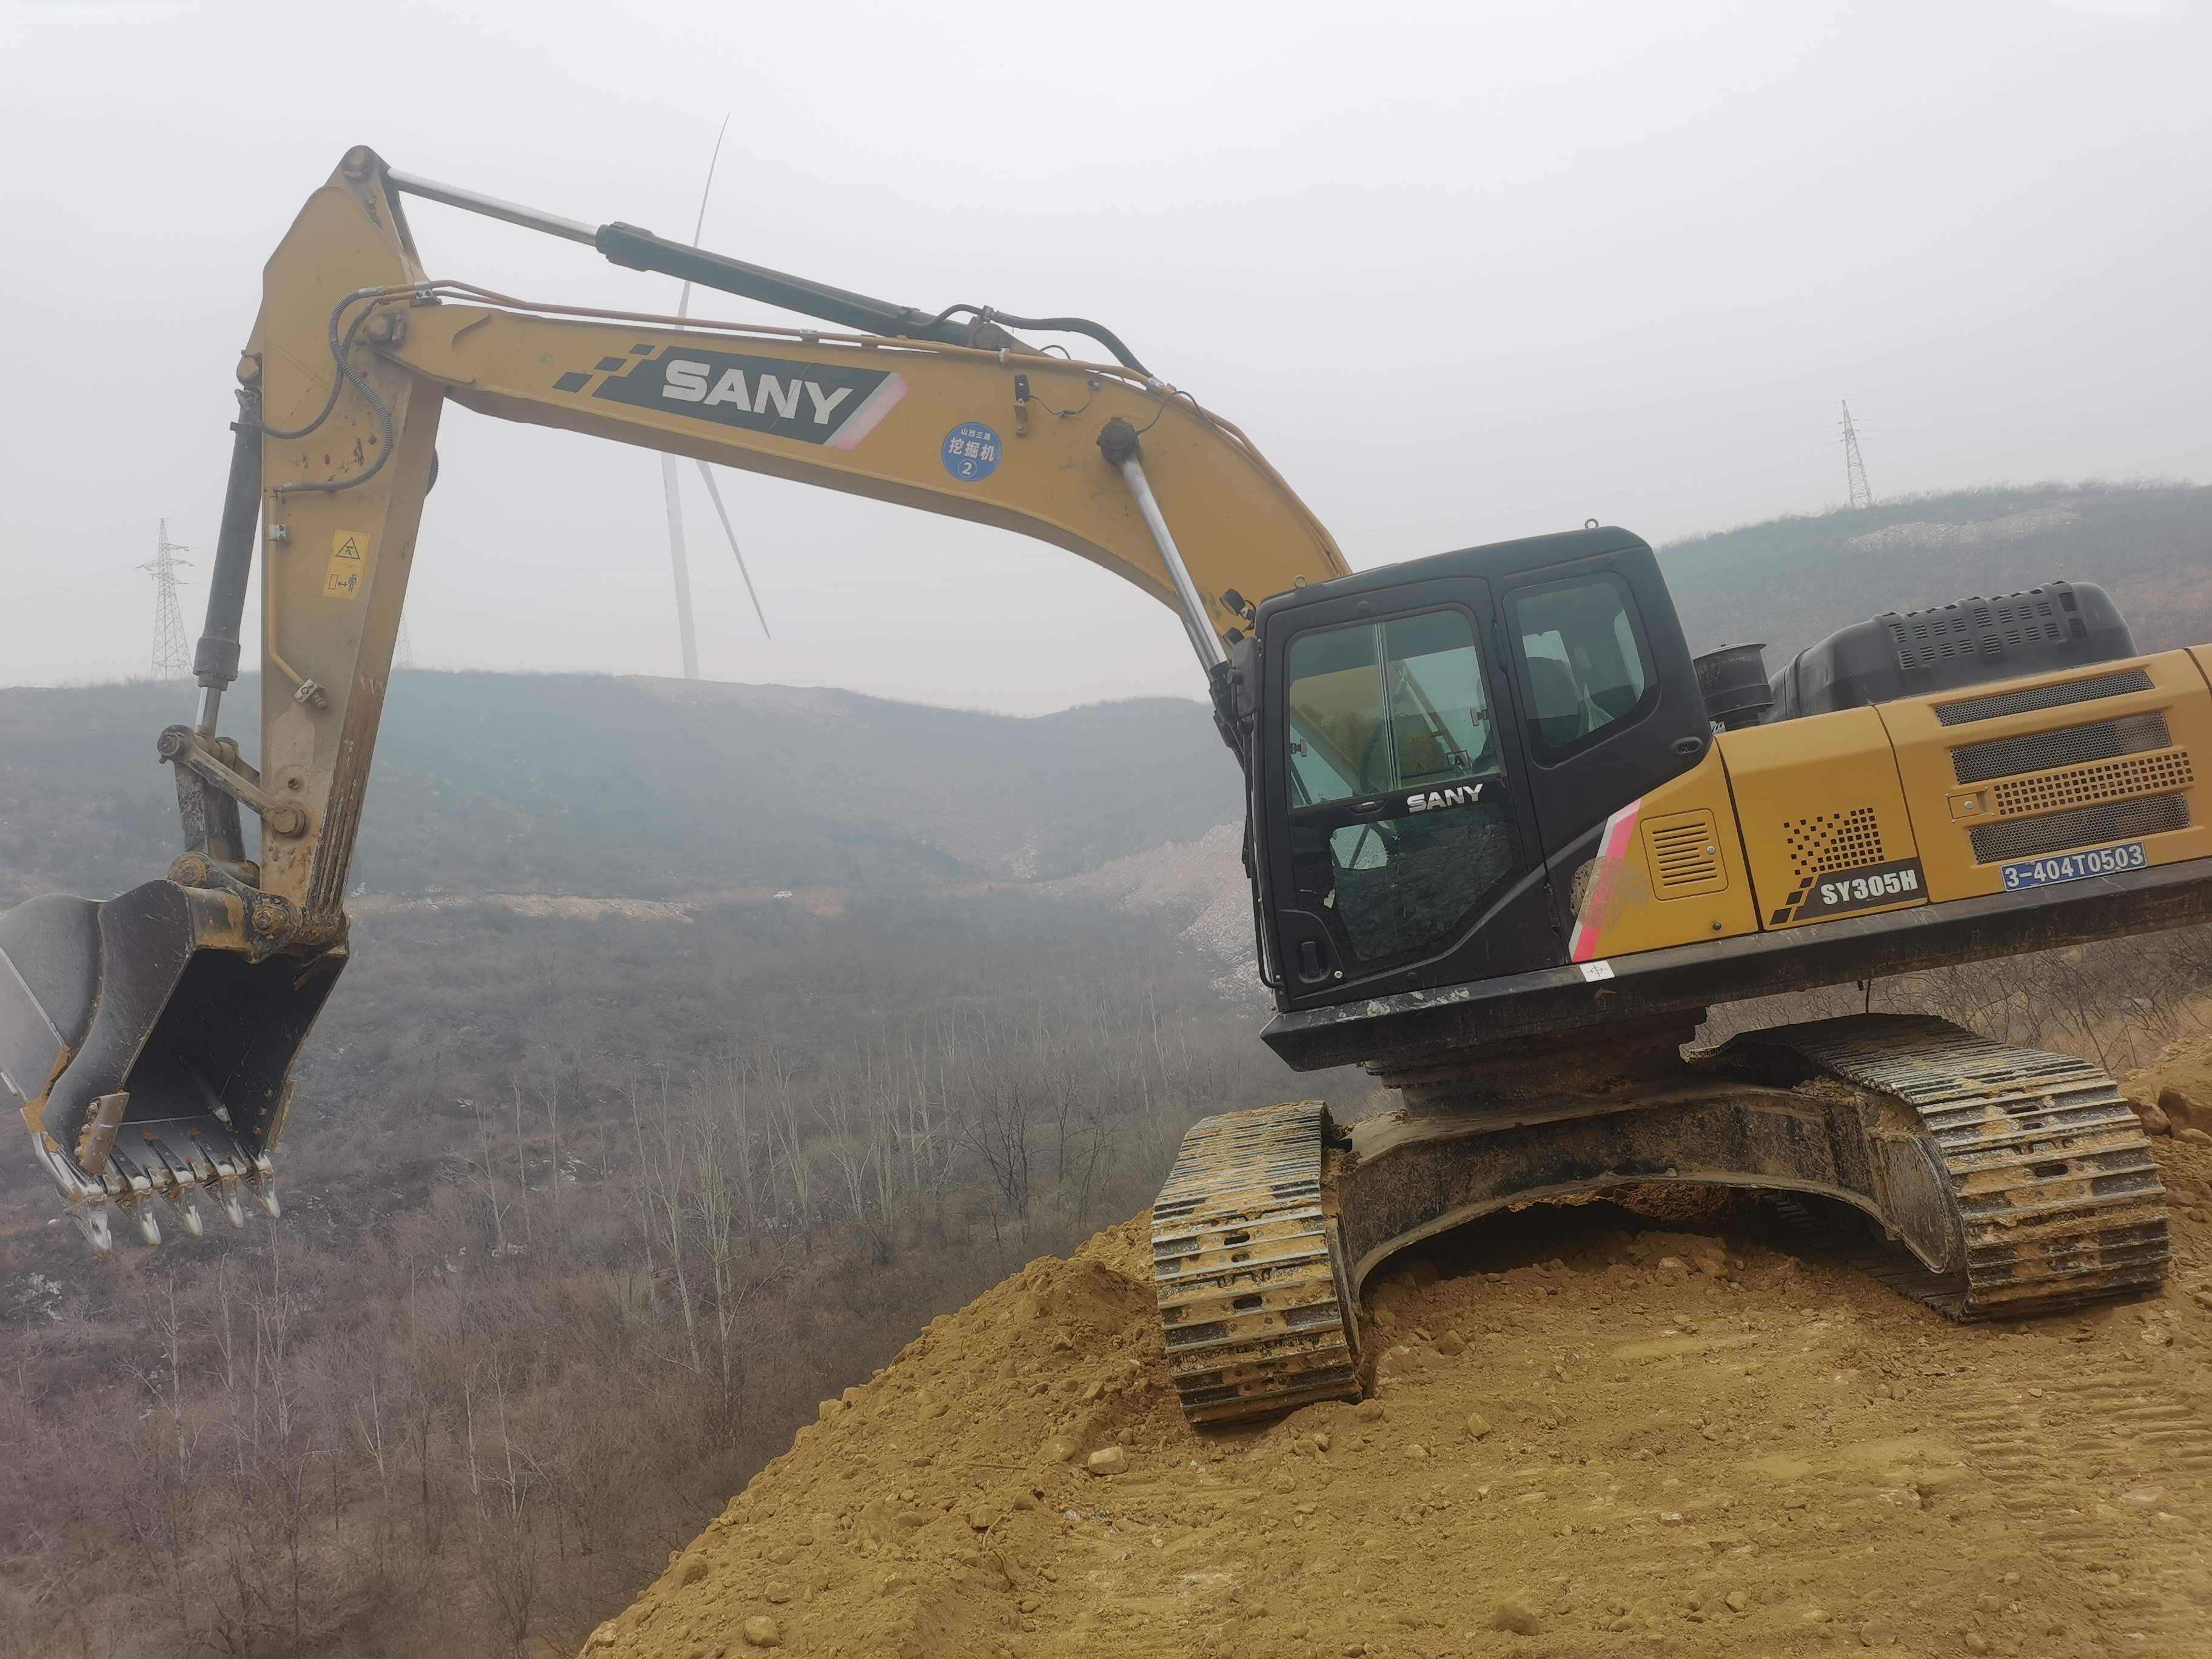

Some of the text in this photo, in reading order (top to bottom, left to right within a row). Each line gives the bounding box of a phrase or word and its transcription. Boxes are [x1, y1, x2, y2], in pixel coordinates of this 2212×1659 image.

[662, 359, 853, 425] SANY
[948, 437, 994, 462] 挖掘机
[962, 462, 972, 475] 2
[1407, 783, 1484, 813] SANY
[2005, 845, 2144, 888] 3-404T0503
[1820, 870, 1919, 905] SY305H
